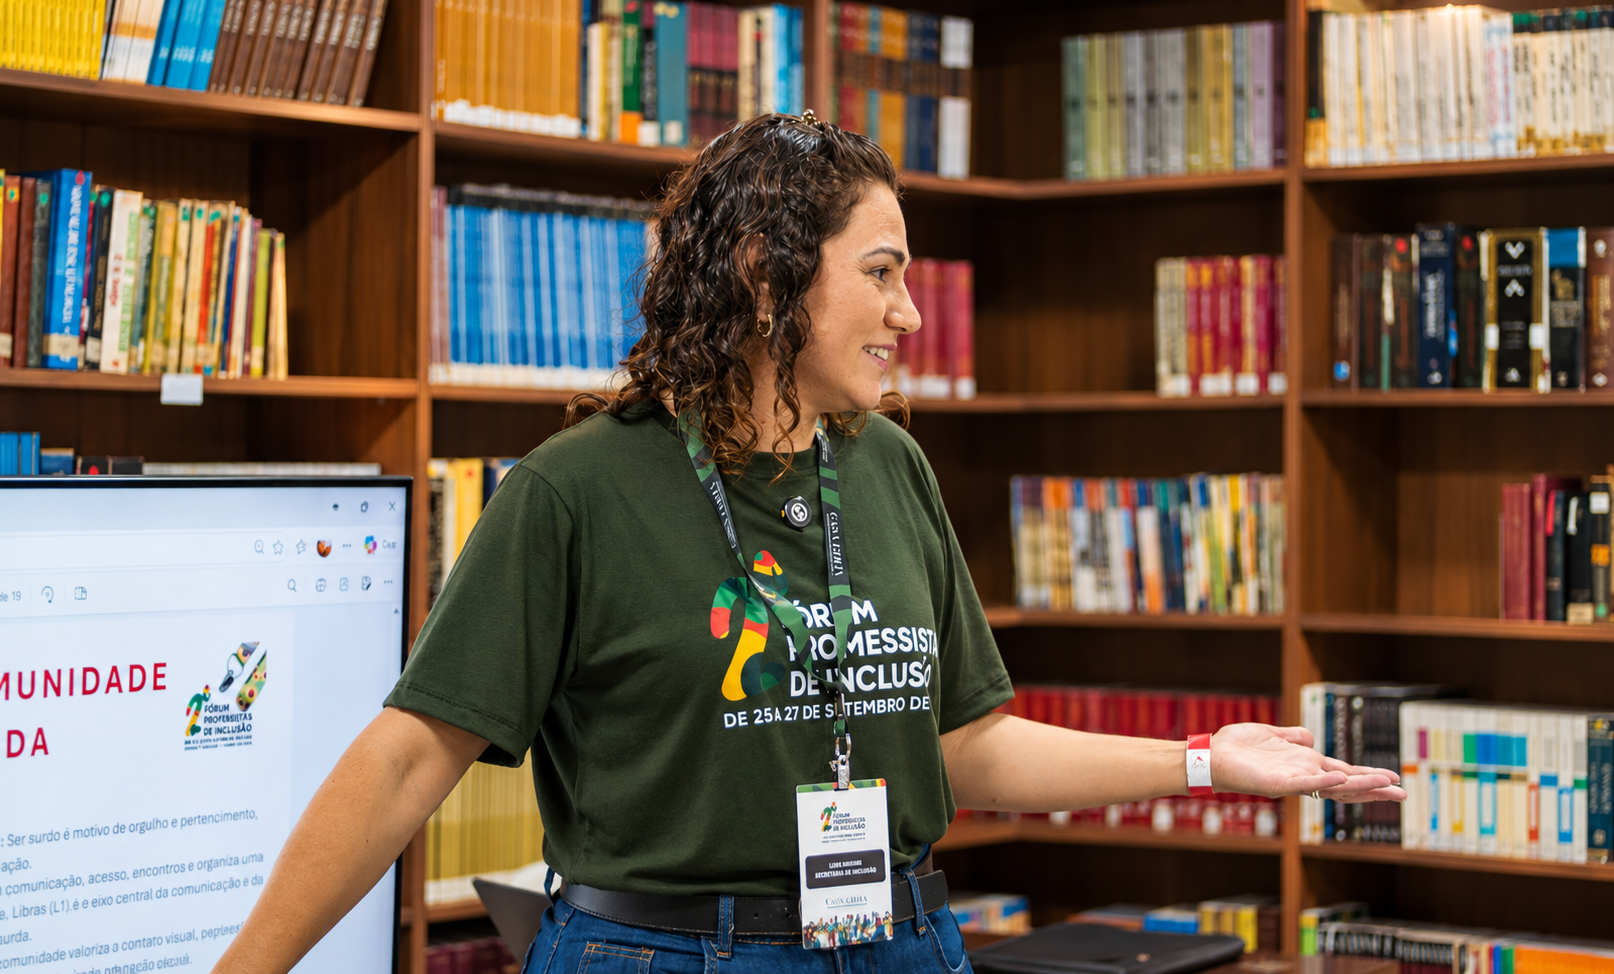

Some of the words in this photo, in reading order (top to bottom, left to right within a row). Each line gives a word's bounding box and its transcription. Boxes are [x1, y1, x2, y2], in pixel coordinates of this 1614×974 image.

[12, 590, 21, 601] 19
[723, 711, 749, 728] DE
[784, 705, 799, 720] 27
[803, 704, 820, 719] DE
[825, 697, 905, 718] STEMBRO
[910, 696, 930, 710] DE
[204, 727, 212, 736] DE
[7, 833, 26, 847] Ser
[28, 829, 60, 845] surdo
[64, 827, 70, 840] é
[73, 824, 110, 839] motivo
[112, 822, 126, 835] de
[128, 818, 168, 834] orgulho
[171, 818, 178, 828] e
[180, 809, 258, 829] pertencimento,
[5, 874, 85, 896] comunicação,
[88, 870, 130, 885] acesso,
[132, 863, 186, 879] encontros
[188, 861, 194, 872] e
[197, 854, 239, 872] organiza
[242, 852, 264, 865] uma
[12, 904, 47, 919] Libras
[82, 899, 89, 909] e
[91, 894, 114, 908] eixo
[116, 887, 153, 905] central
[155, 887, 169, 899] da
[171, 877, 241, 897] comunicação
[243, 877, 249, 887] e
[251, 874, 264, 886] da
[68, 943, 110, 959] valoriza
[112, 942, 119, 953] a
[121, 935, 164, 951] contato
[165, 929, 198, 944] visual,
